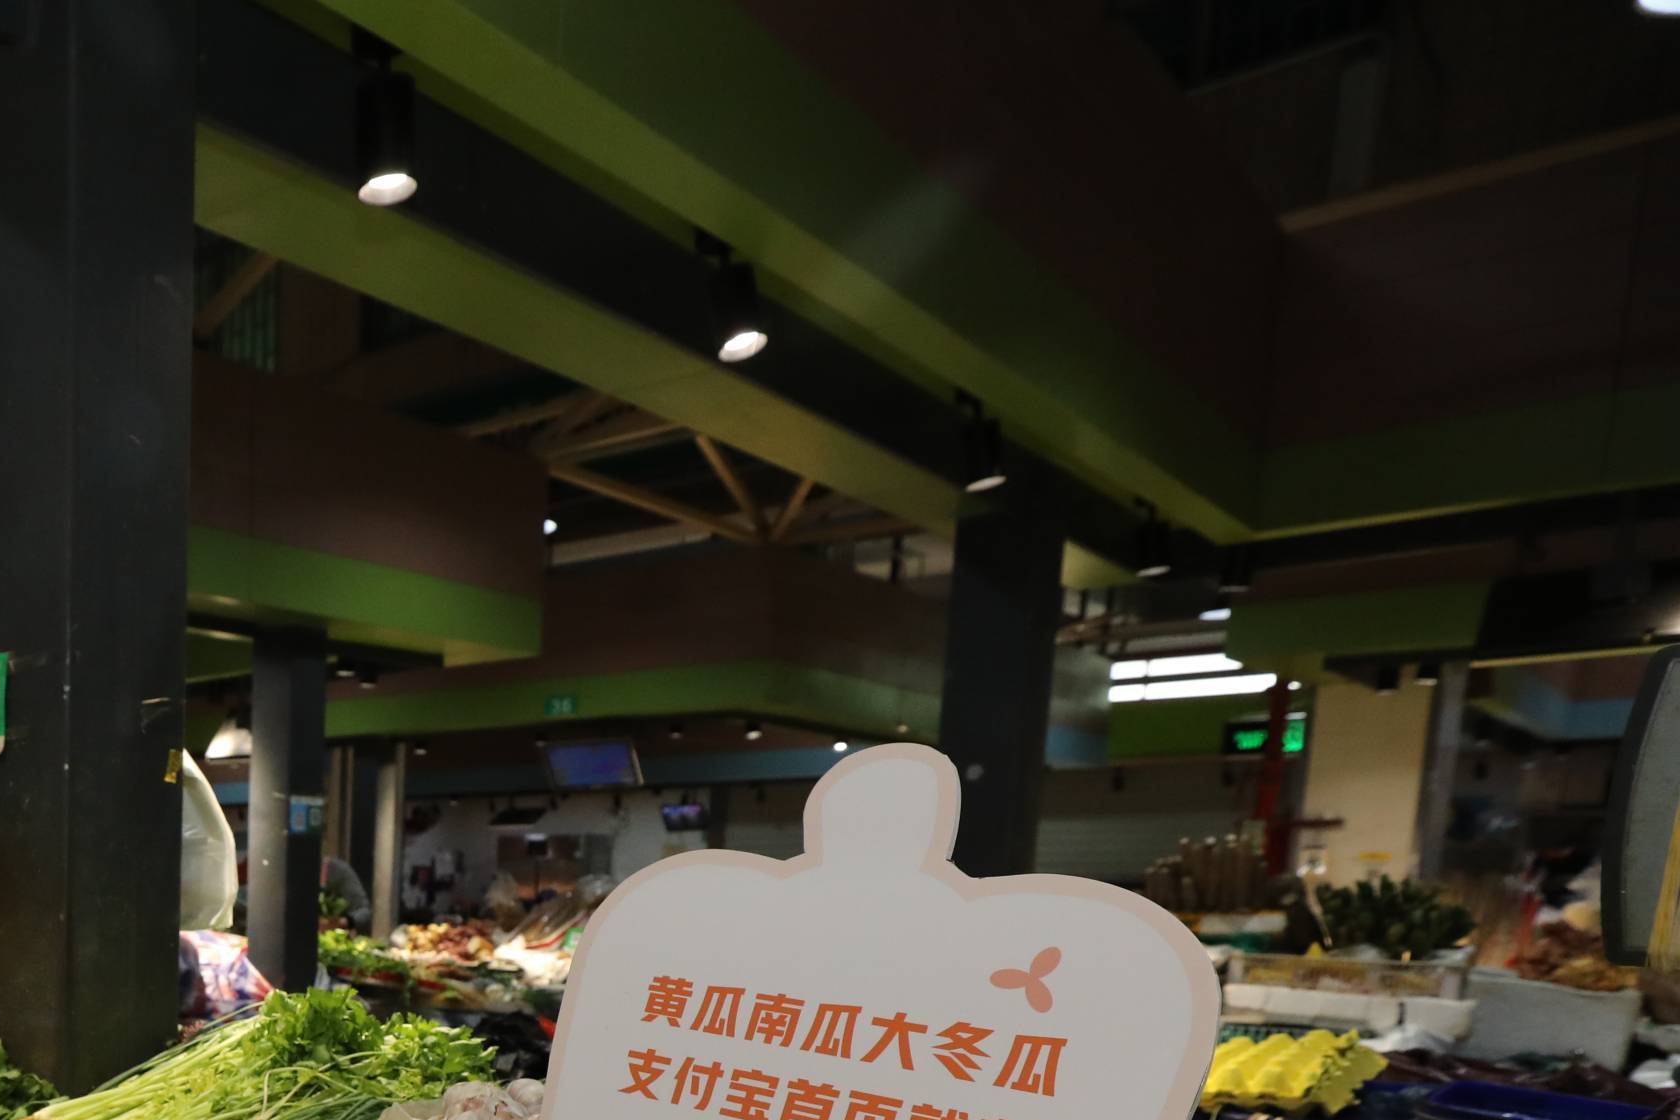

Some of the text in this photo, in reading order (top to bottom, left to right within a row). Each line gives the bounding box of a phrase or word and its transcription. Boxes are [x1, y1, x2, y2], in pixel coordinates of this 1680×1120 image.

[640, 976, 1067, 1097] 黄瓜南瓜大冬瓜
